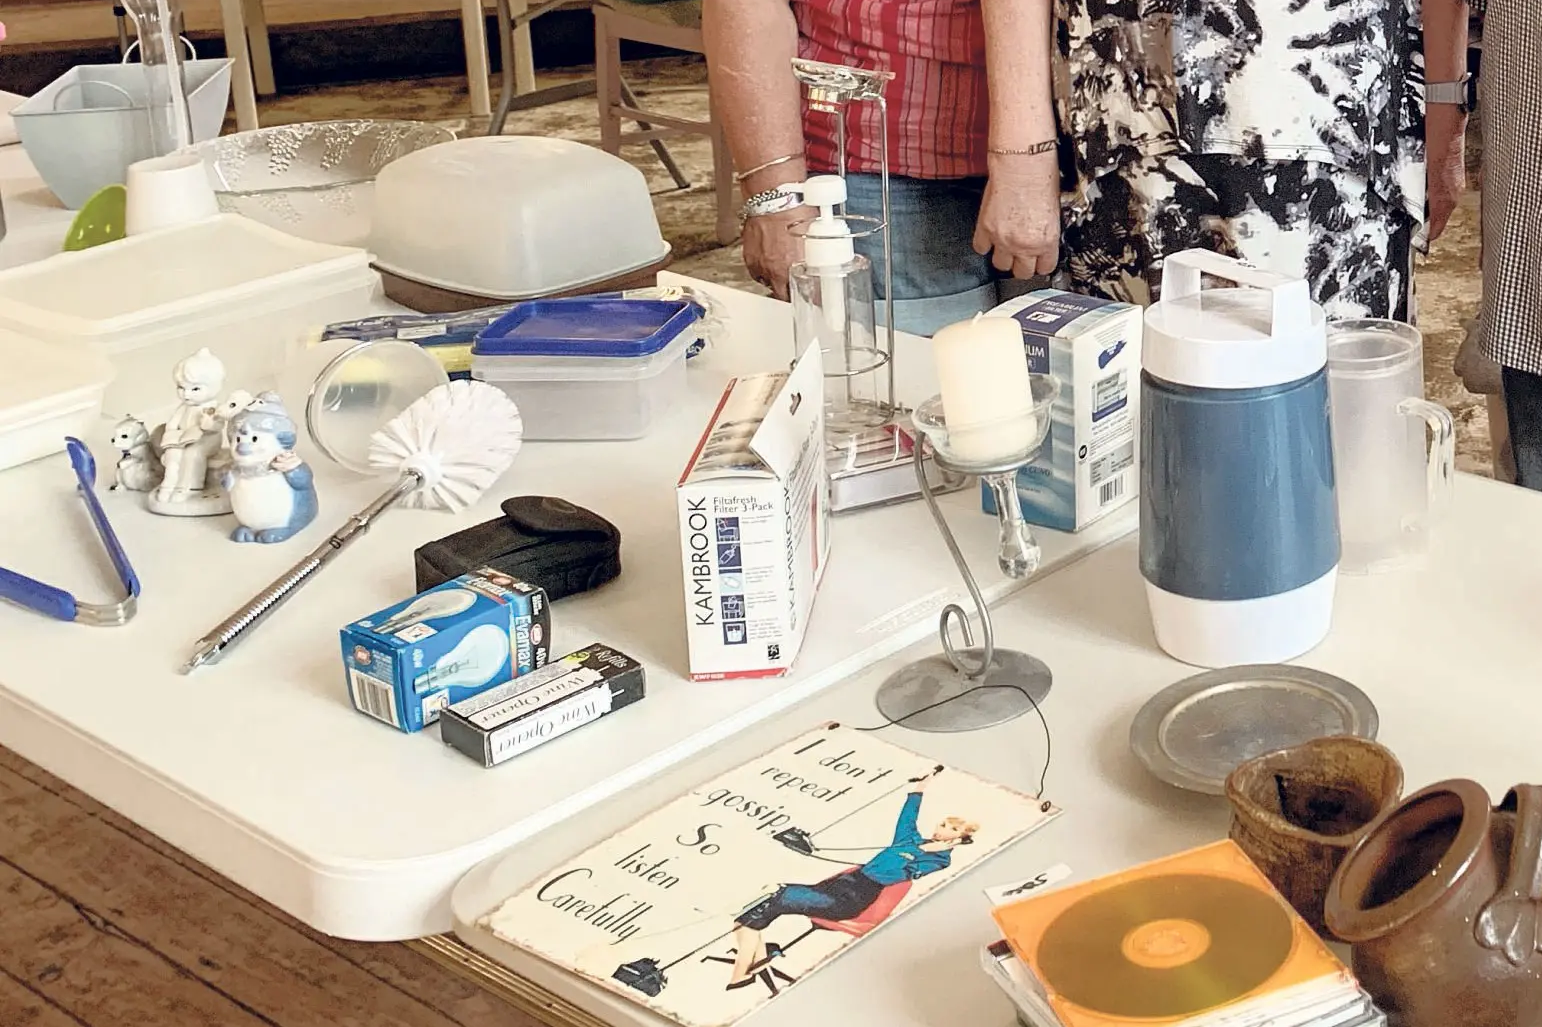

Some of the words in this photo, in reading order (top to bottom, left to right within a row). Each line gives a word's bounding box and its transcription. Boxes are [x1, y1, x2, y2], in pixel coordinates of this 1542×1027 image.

[713, 495, 757, 506] Filtafresh
[714, 504, 739, 514] Filter
[742, 502, 774, 512] 3-Pack
[687, 496, 715, 627] KAMBROOK
[515, 615, 531, 668] Evamax
[543, 676, 585, 696] Wine
[482, 695, 540, 724] Opener
[559, 701, 597, 725] Wine
[496, 721, 555, 755] Opener
[793, 738, 826, 756] I
[819, 749, 894, 784] don't
[760, 766, 854, 803] repeat
[676, 822, 723, 856] So
[613, 843, 681, 890] listen
[536, 867, 654, 946] Carefully
